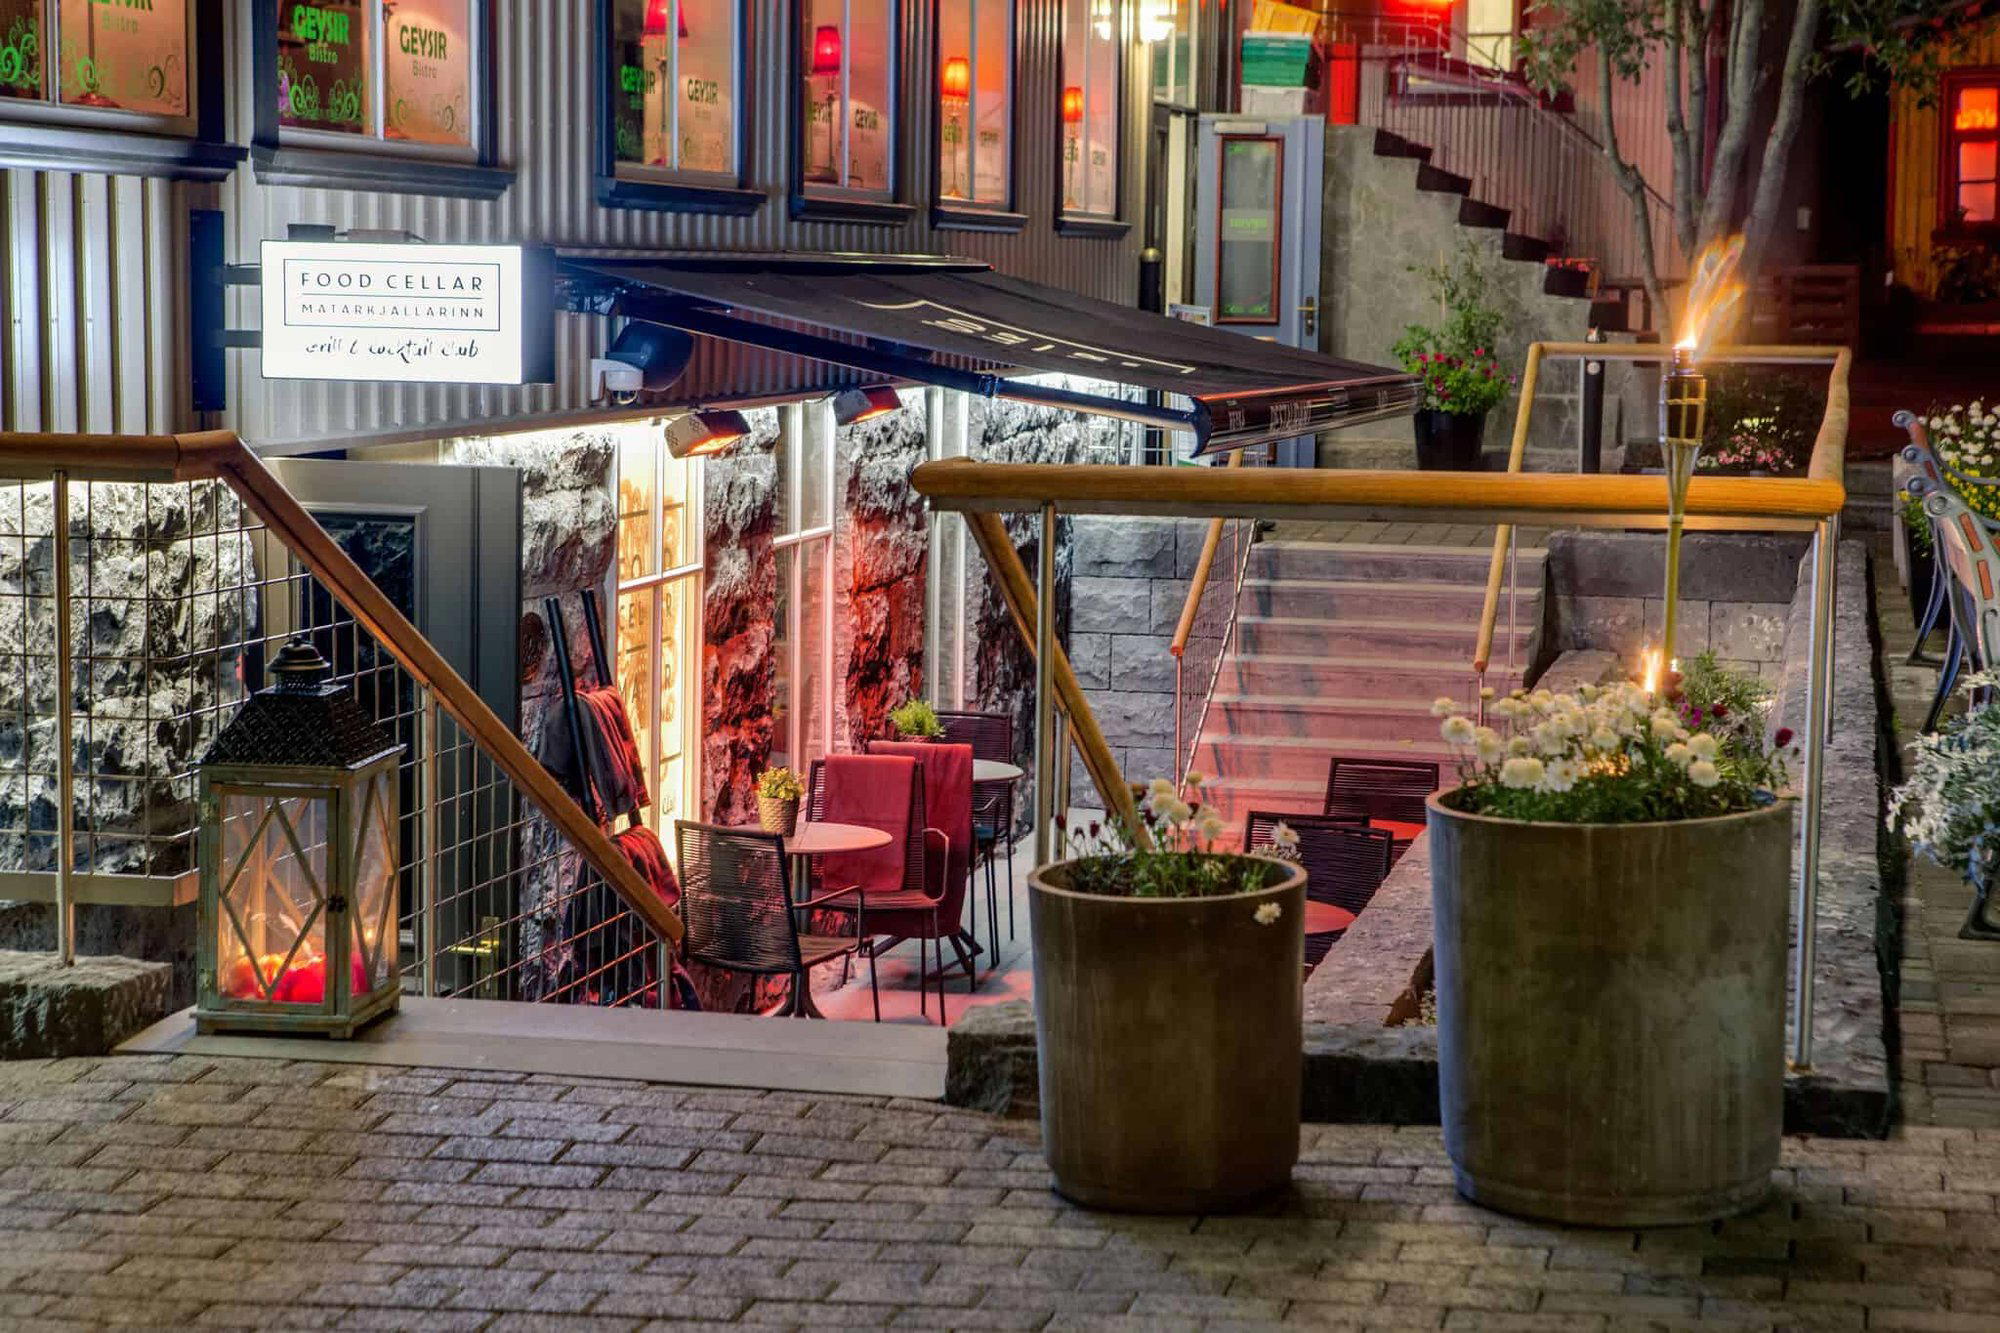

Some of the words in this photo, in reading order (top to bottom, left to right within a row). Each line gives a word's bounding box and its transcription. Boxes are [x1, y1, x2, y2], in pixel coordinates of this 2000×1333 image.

[293, 4, 349, 46] GEYSIR
[307, 41, 339, 64] Bistro
[400, 24, 447, 60] GEYSIR
[301, 272, 372, 289] FOOD
[386, 274, 483, 292] CELLAR
[301, 303, 484, 319] MATARKJALLARINN
